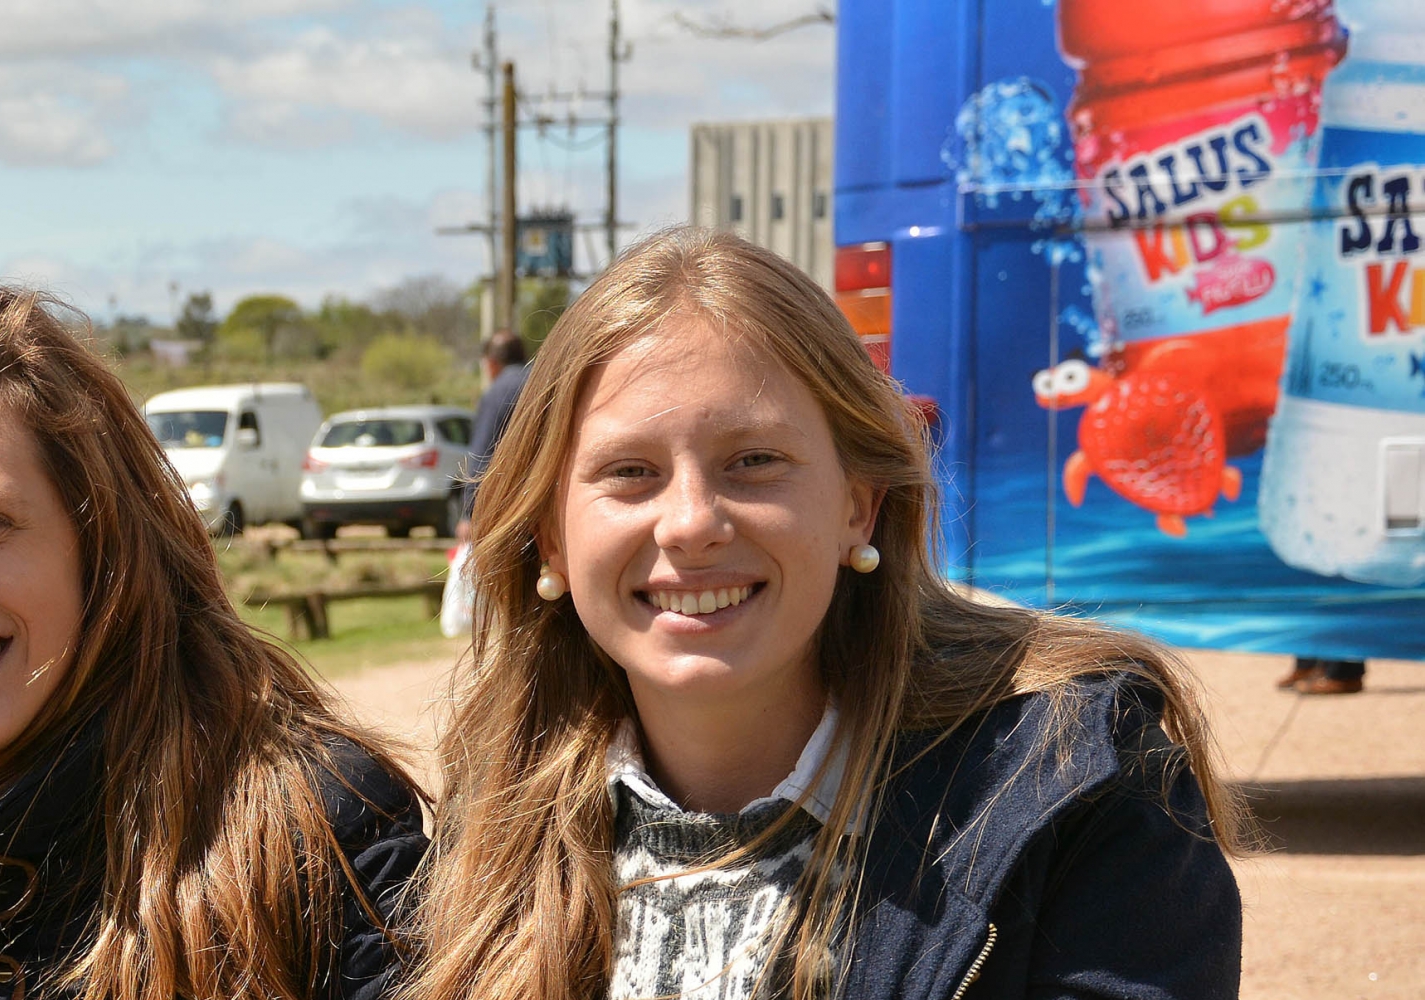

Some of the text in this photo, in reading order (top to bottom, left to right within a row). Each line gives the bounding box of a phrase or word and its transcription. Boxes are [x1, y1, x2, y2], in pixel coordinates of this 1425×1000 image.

[1103, 123, 1271, 229] SALUS
[1341, 174, 1425, 254] SA
[1135, 194, 1271, 283] KIDS
